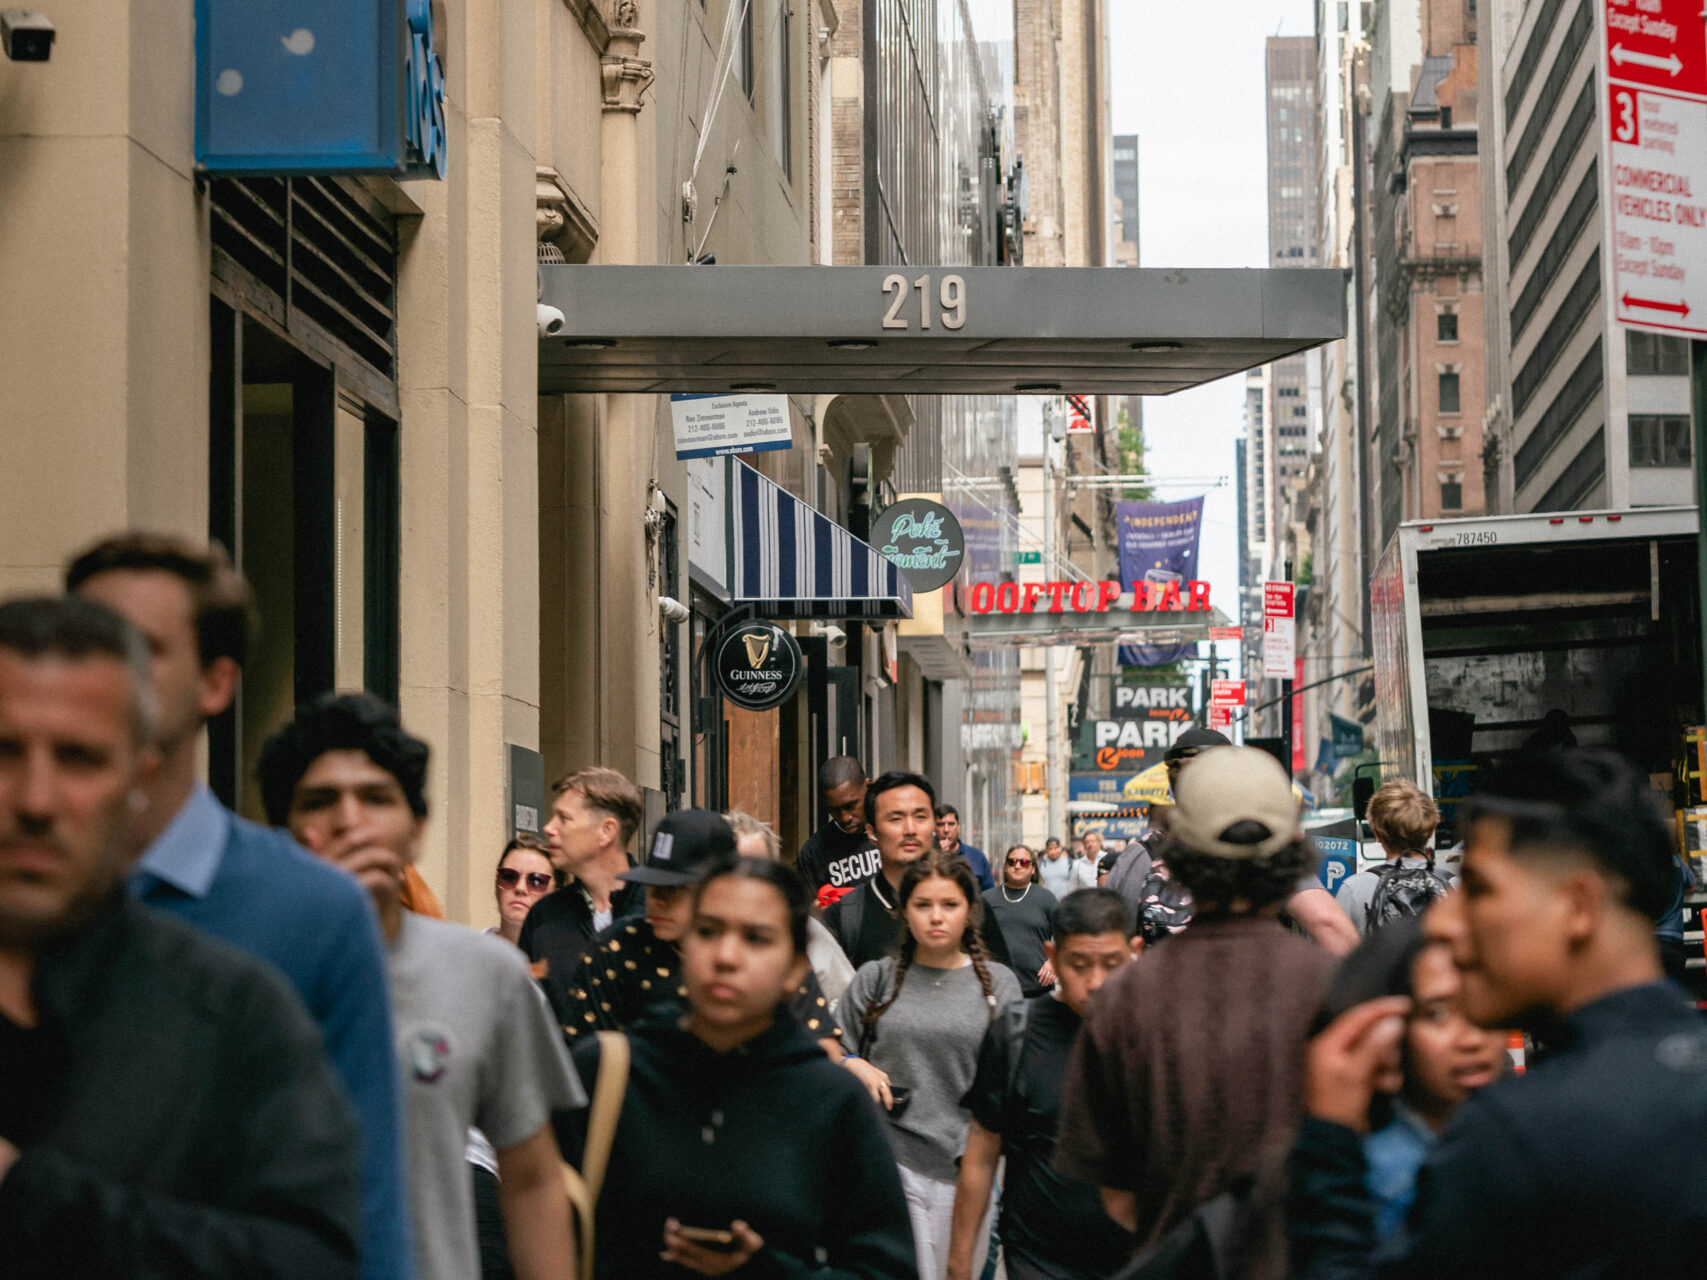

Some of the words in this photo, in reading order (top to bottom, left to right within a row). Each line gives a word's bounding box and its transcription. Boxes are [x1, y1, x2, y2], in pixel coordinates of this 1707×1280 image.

[1607, 7, 1640, 35] Except
[1640, 14, 1678, 44] Sunday
[1616, 91, 1635, 142] 3
[1615, 164, 1693, 198] COMMERCIAL
[1615, 193, 1672, 223] VEHICLES
[1674, 203, 1706, 228] ONLY
[882, 274, 967, 330] 219
[1456, 531, 1497, 545] 787450
[971, 581, 1121, 614] OOFTOP
[1130, 580, 1212, 612] BAR
[730, 669, 783, 680] GUINNESS
[1116, 687, 1188, 708] PARK
[1096, 720, 1195, 748] PARK
[828, 848, 883, 887] SECUR
